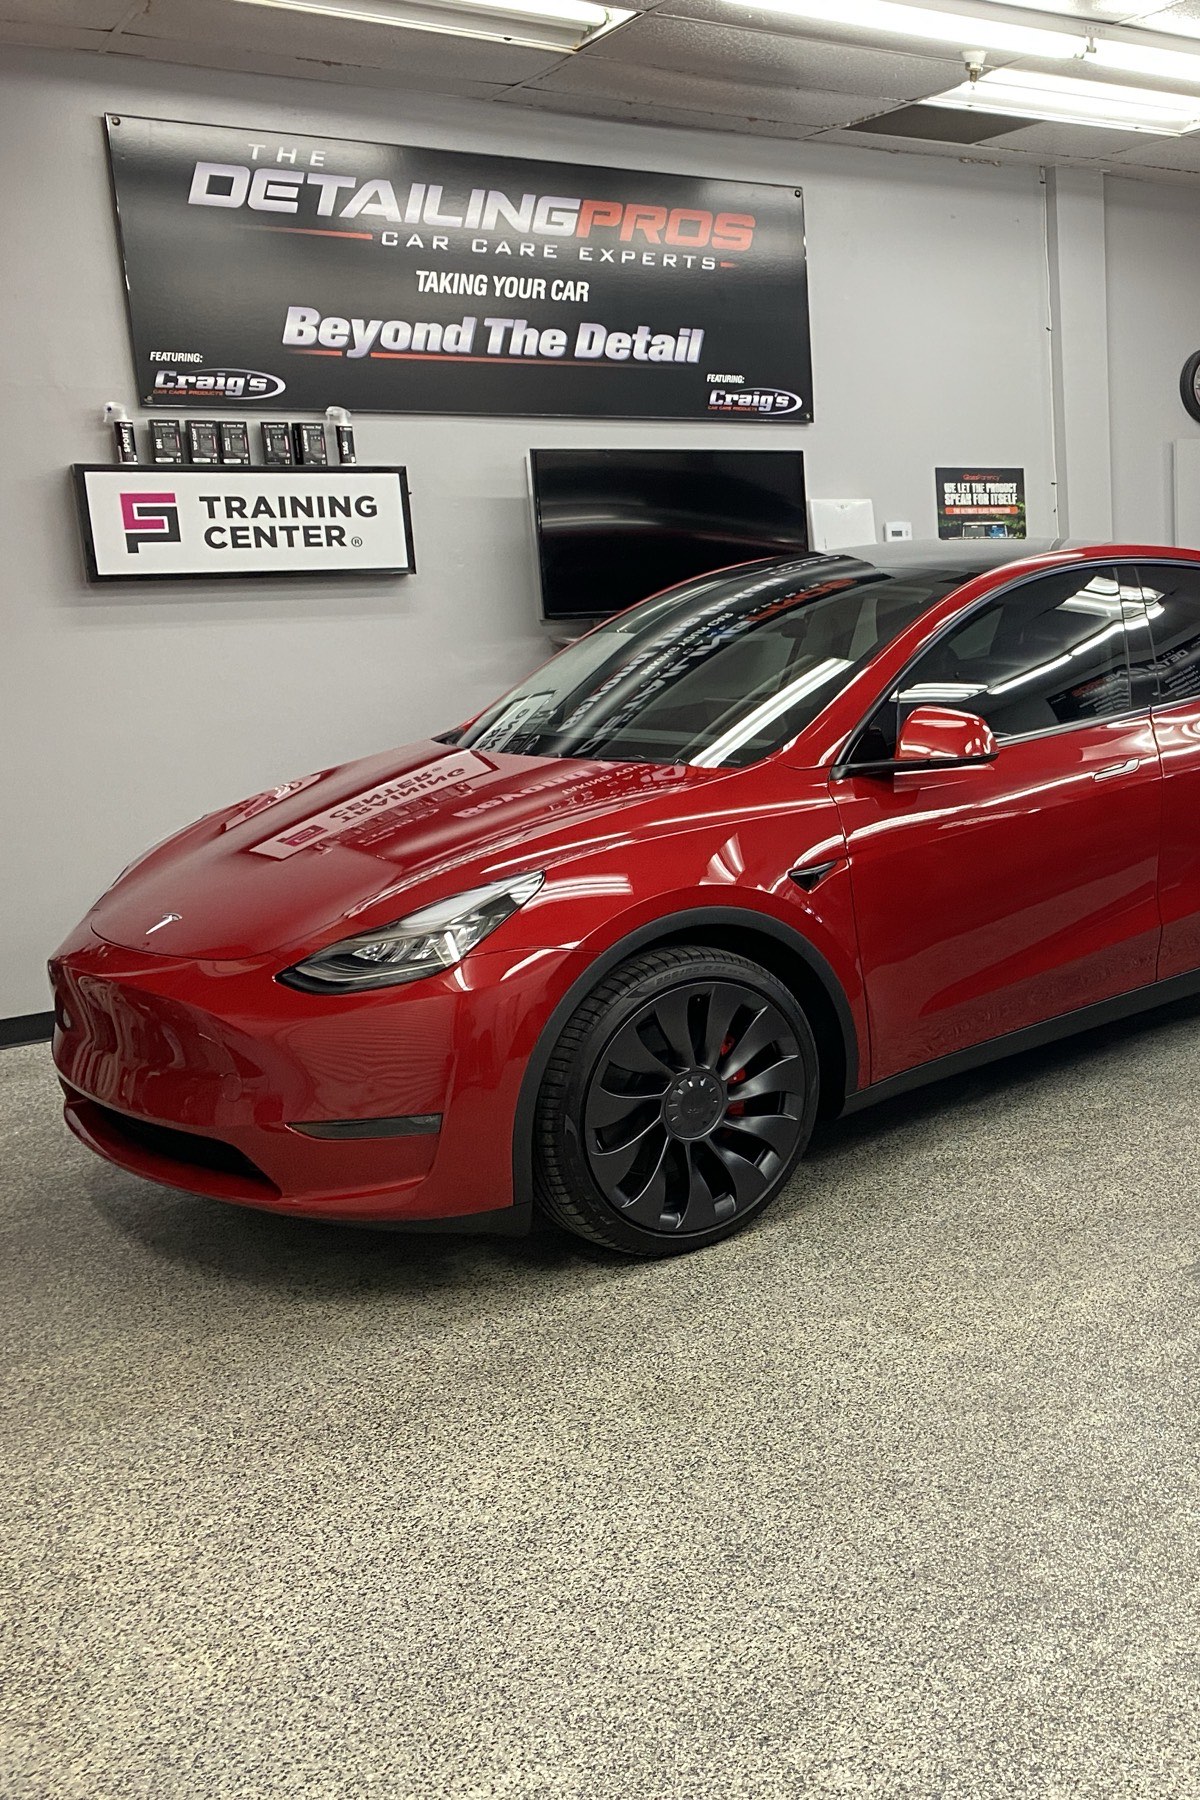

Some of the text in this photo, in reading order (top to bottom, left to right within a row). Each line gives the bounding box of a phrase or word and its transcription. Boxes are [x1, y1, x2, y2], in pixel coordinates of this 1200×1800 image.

[248, 143, 326, 167] THE
[188, 161, 757, 251] DETAILINGPROS
[381, 231, 717, 271] CAR CARE EXPERTS
[416, 270, 590, 302] TAKING YOUR CAR
[281, 305, 706, 364] Beyond The Detail
[149, 351, 204, 363] FEATURING:
[154, 370, 268, 396] Craig's
[706, 373, 745, 384] FEATURING:
[709, 389, 790, 412] Craig's
[121, 428, 131, 453] SPORT
[155, 438, 163, 450] 9H
[341, 440, 349, 455] TAG
[943, 482, 957, 493] WE
[957, 482, 971, 493] LET
[971, 482, 985, 493] THE
[972, 493, 990, 505] FOR
[990, 493, 1018, 505] ITSELF
[198, 494, 378, 519] TRAINING
